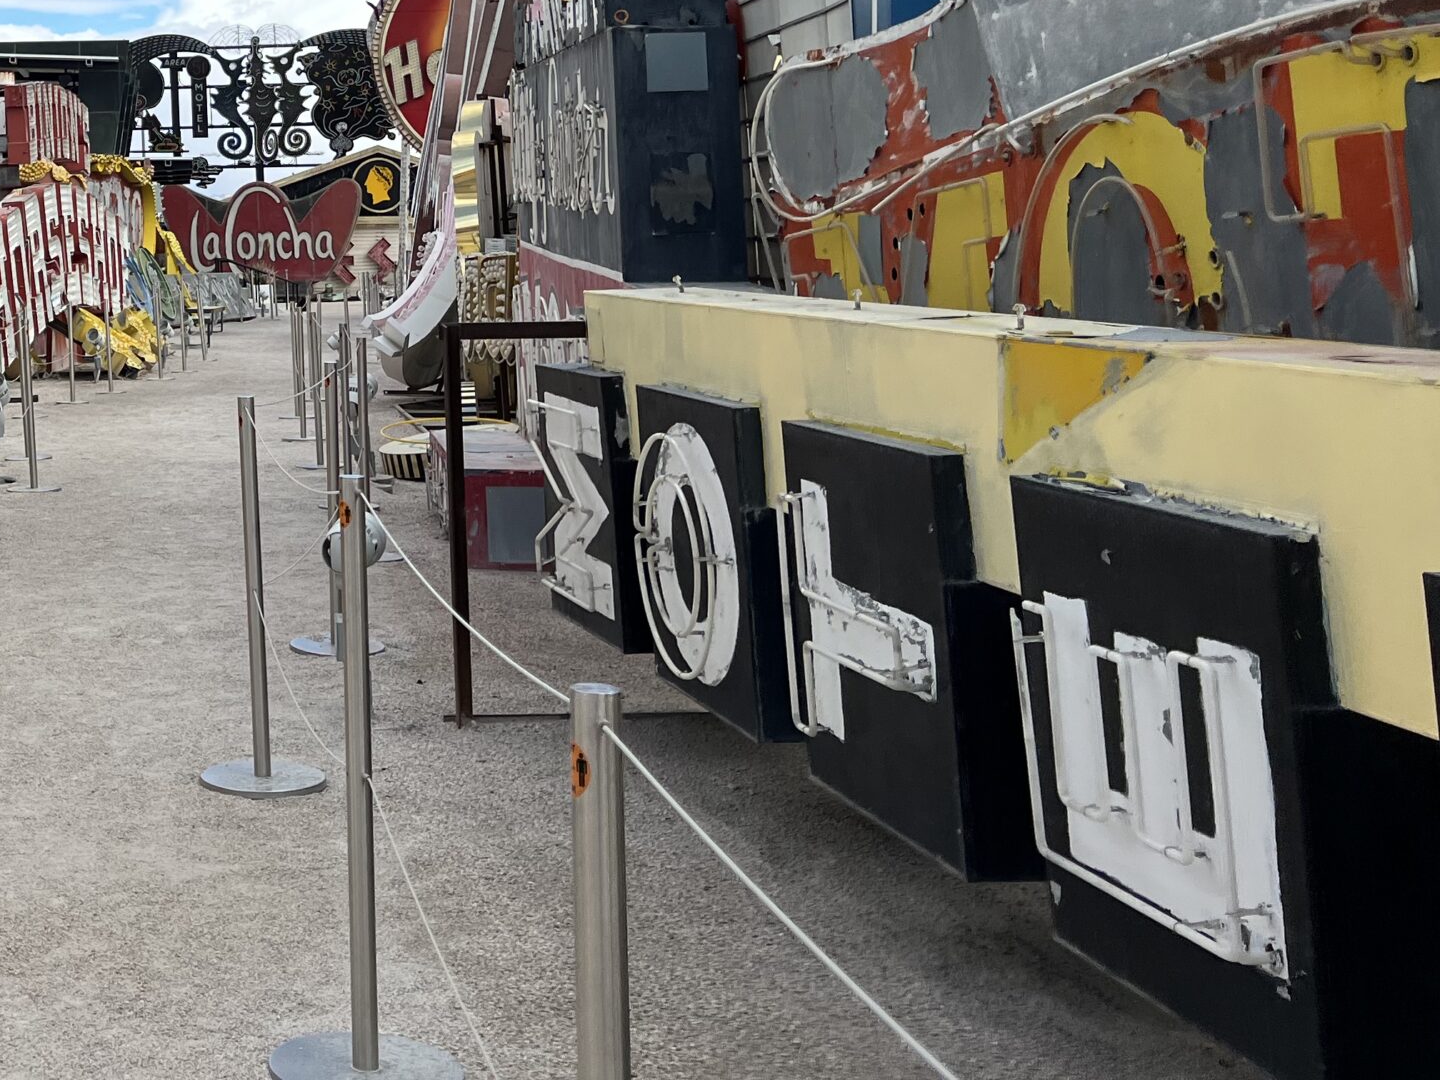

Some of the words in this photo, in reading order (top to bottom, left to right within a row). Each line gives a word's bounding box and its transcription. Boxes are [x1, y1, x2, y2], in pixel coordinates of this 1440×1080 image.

[164, 58, 186, 67] AREA
[194, 83, 204, 133] MOTEL
[190, 209, 221, 273] La
[224, 186, 336, 278] Concha
